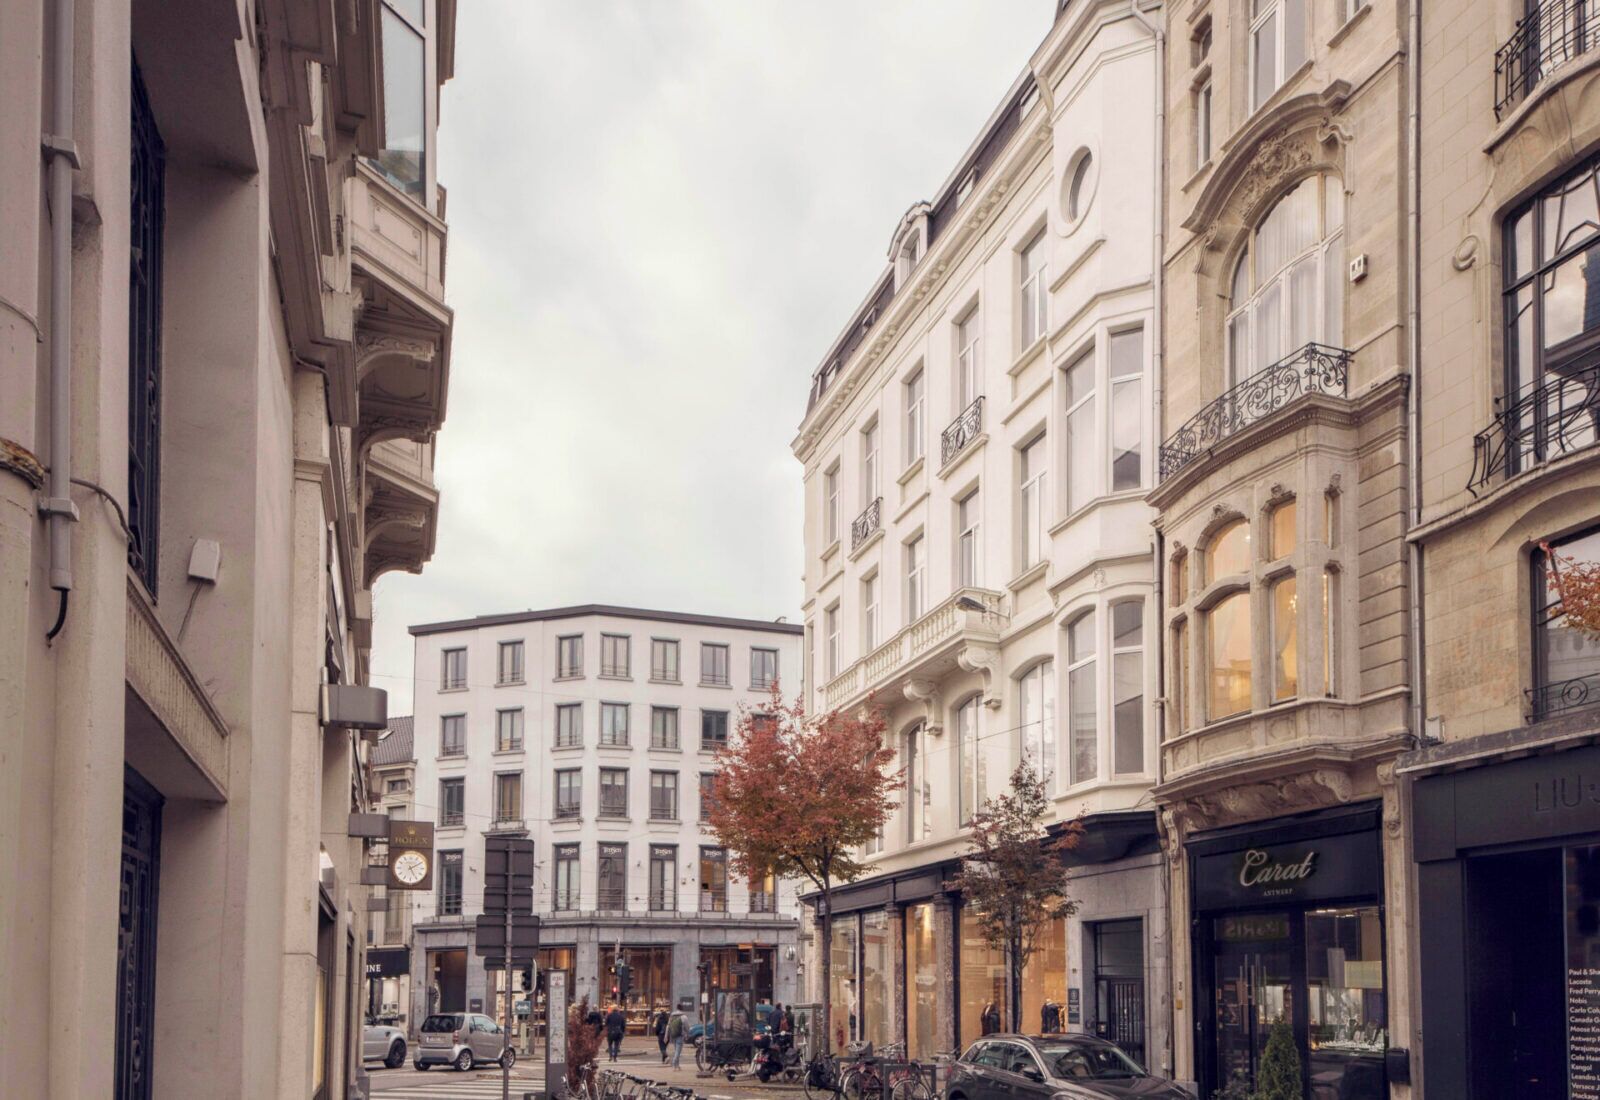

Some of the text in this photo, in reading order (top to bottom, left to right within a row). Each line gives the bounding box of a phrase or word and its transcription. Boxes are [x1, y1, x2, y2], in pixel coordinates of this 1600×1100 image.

[1240, 850, 1314, 887] Carat
[1263, 888, 1293, 897] ANTWERP
[1571, 1035, 1596, 1043] Antwerp
[1571, 1063, 1593, 1072] Kangol
[1572, 1082, 1595, 1090] Versace
